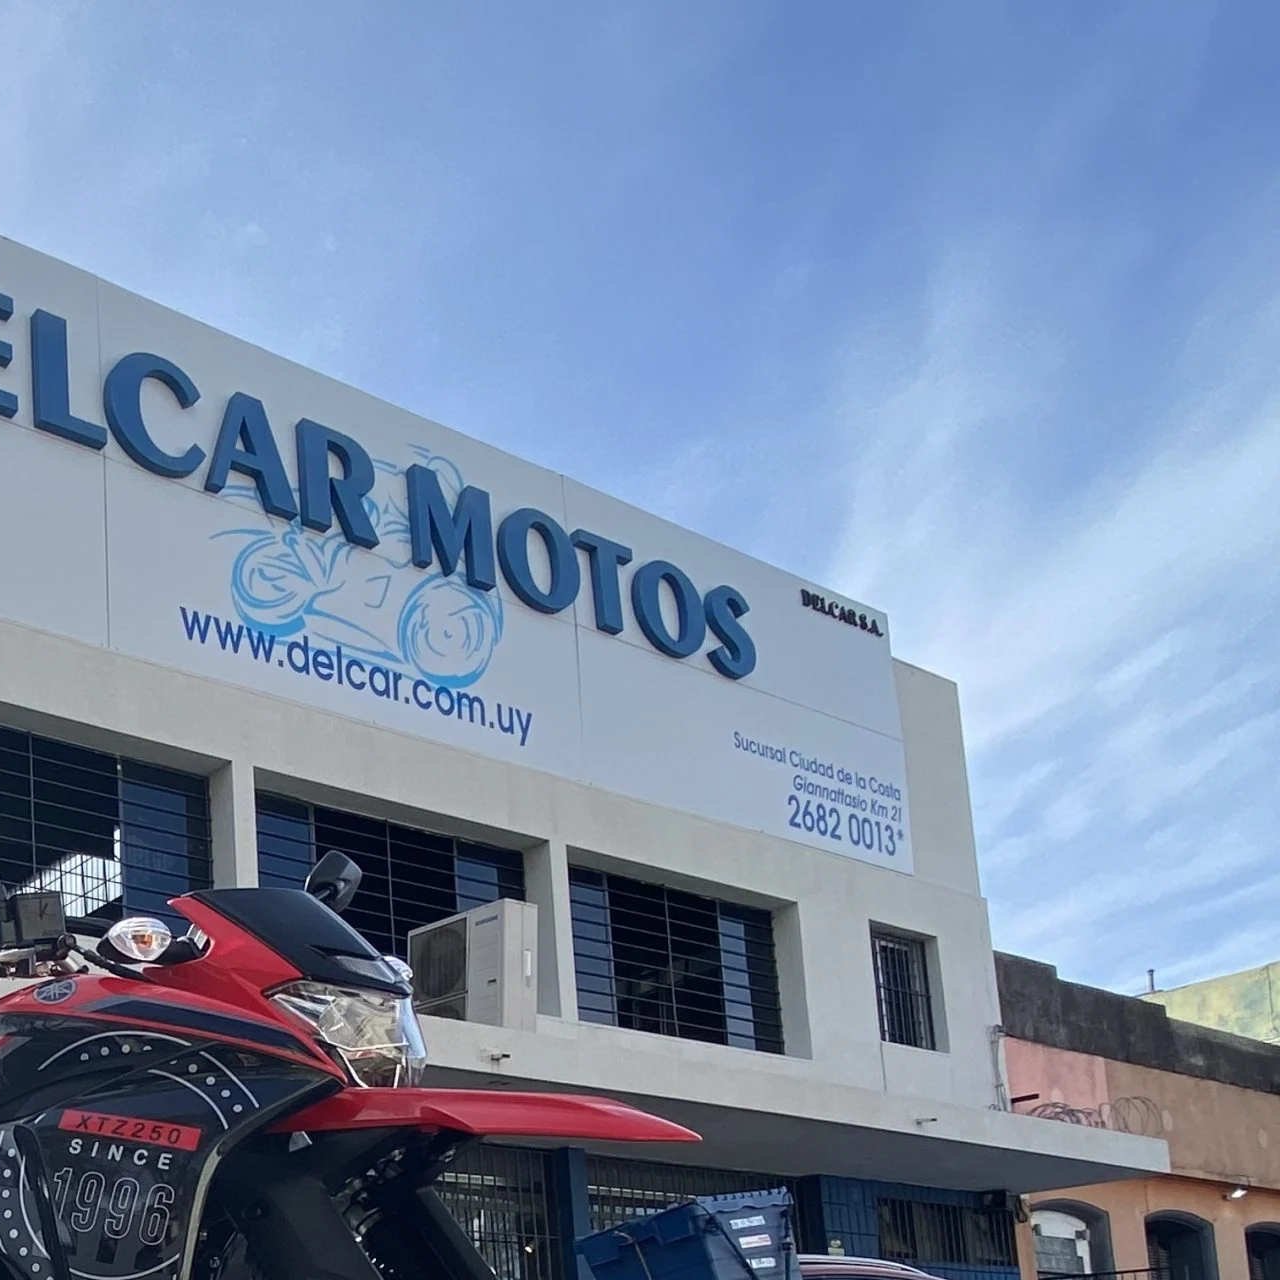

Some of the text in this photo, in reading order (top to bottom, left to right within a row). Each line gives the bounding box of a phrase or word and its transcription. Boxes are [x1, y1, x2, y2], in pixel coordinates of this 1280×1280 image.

[406, 463, 757, 680] MOTOS
[800, 588, 858, 627] DELCAR
[179, 606, 534, 747] www.delcar.com.uy
[733, 731, 902, 801] Sucursal Ciudad de la Costa
[787, 795, 842, 841] 2682
[793, 775, 903, 823] Giannattasio Km 21
[76, 1114, 182, 1145] XTZ250
[69, 1138, 173, 1170] SINCE
[54, 1167, 176, 1246] 1996
